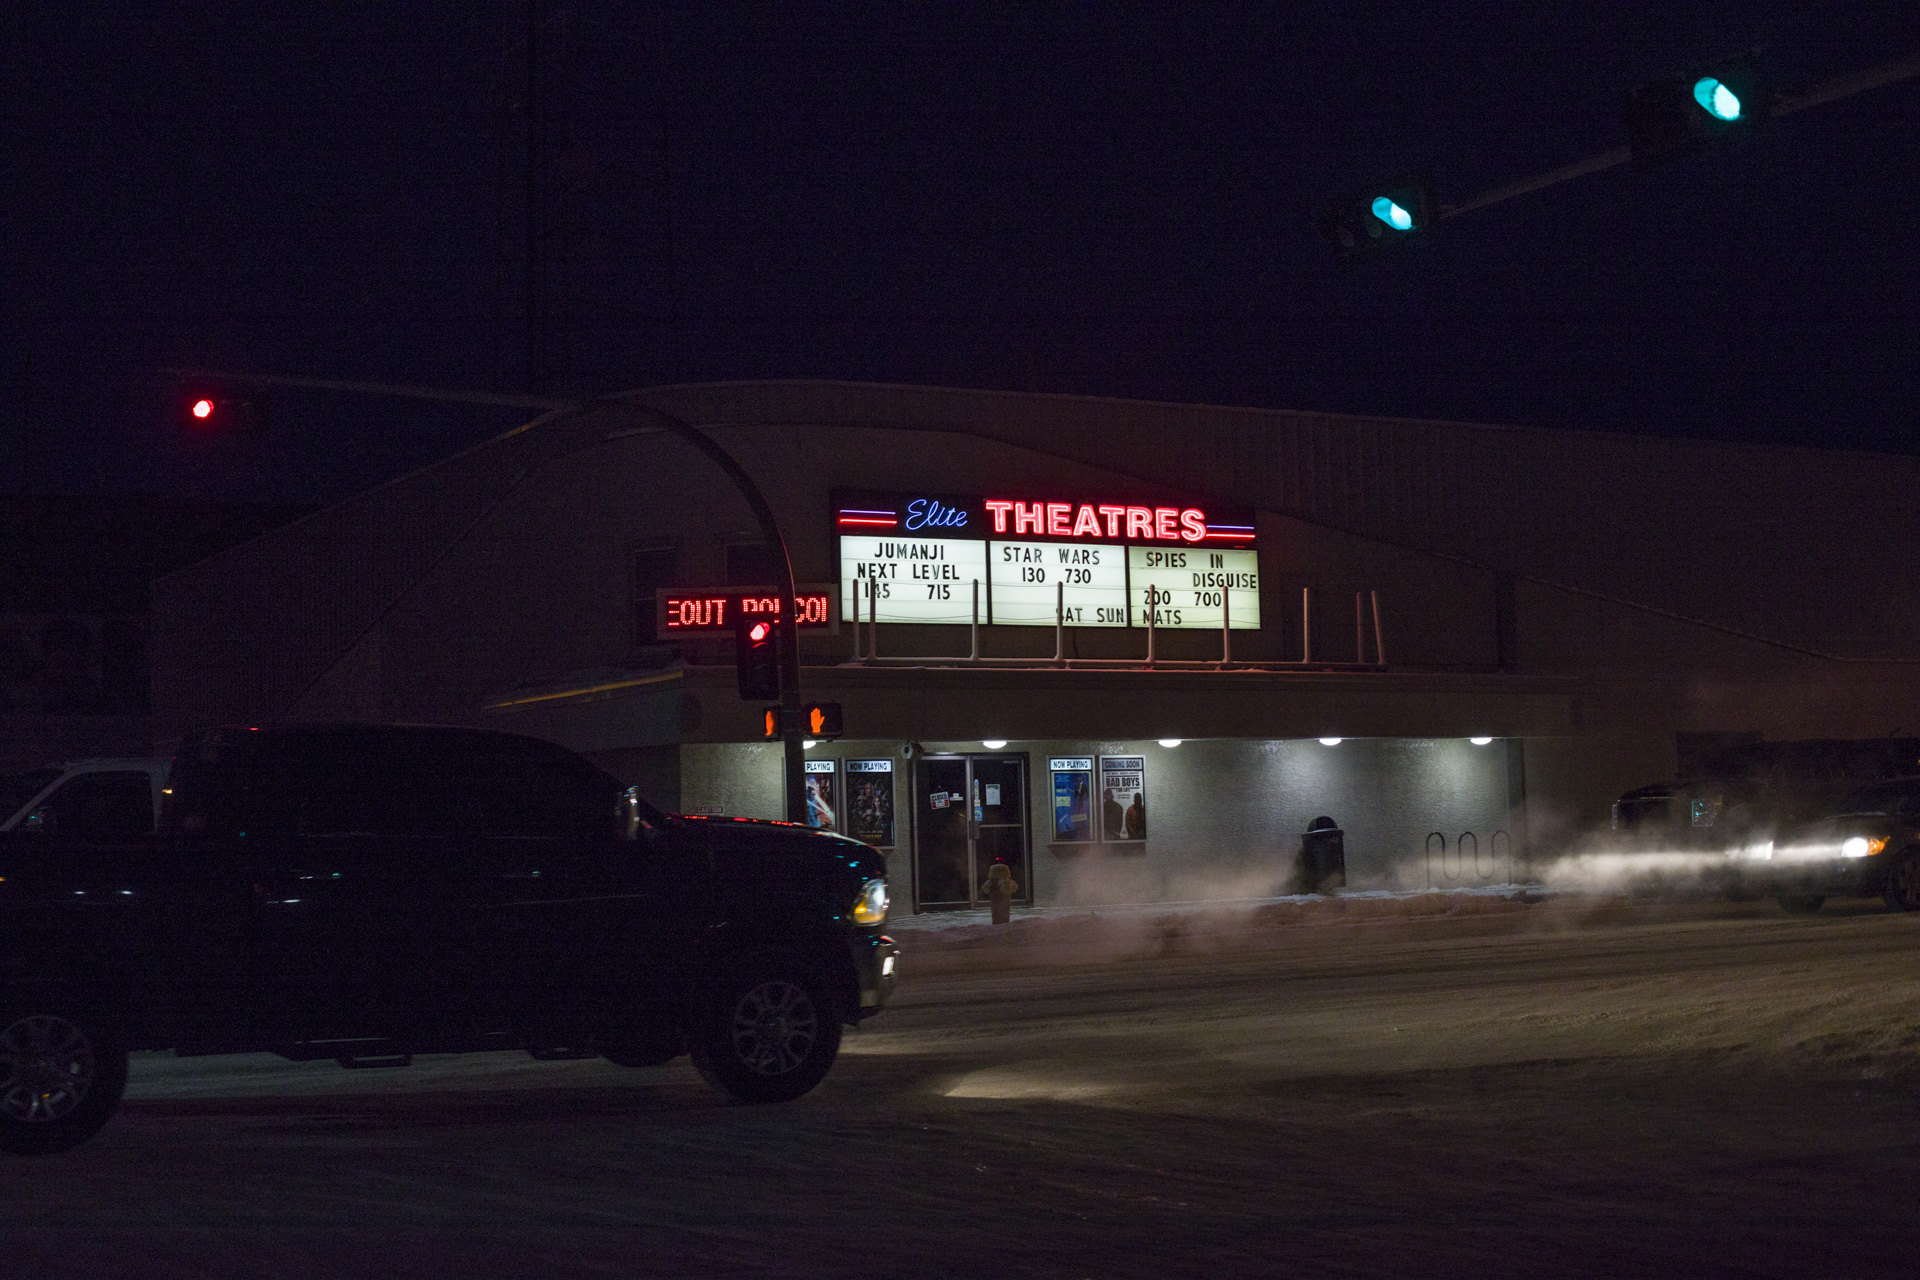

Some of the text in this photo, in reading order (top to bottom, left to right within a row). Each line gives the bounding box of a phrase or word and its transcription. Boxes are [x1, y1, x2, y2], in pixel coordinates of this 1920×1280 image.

[905, 499, 1207, 541] Elite THEATRES
[874, 542, 944, 560] JUMANJI
[1003, 546, 1100, 565] STAR WARS
[1146, 551, 1223, 569] SPIES IN
[857, 562, 960, 580] NEXT LEVEL
[1022, 567, 1091, 584] 130 730
[1193, 572, 1257, 589] DISGUISE
[927, 584, 950, 600] 715
[1144, 590, 1221, 607] 200 700
[1097, 607, 1124, 623] SUN
[806, 762, 831, 770] PLAYING
[849, 762, 887, 770] NOW PLAYING
[1106, 777, 1140, 787] BAD BOYS
